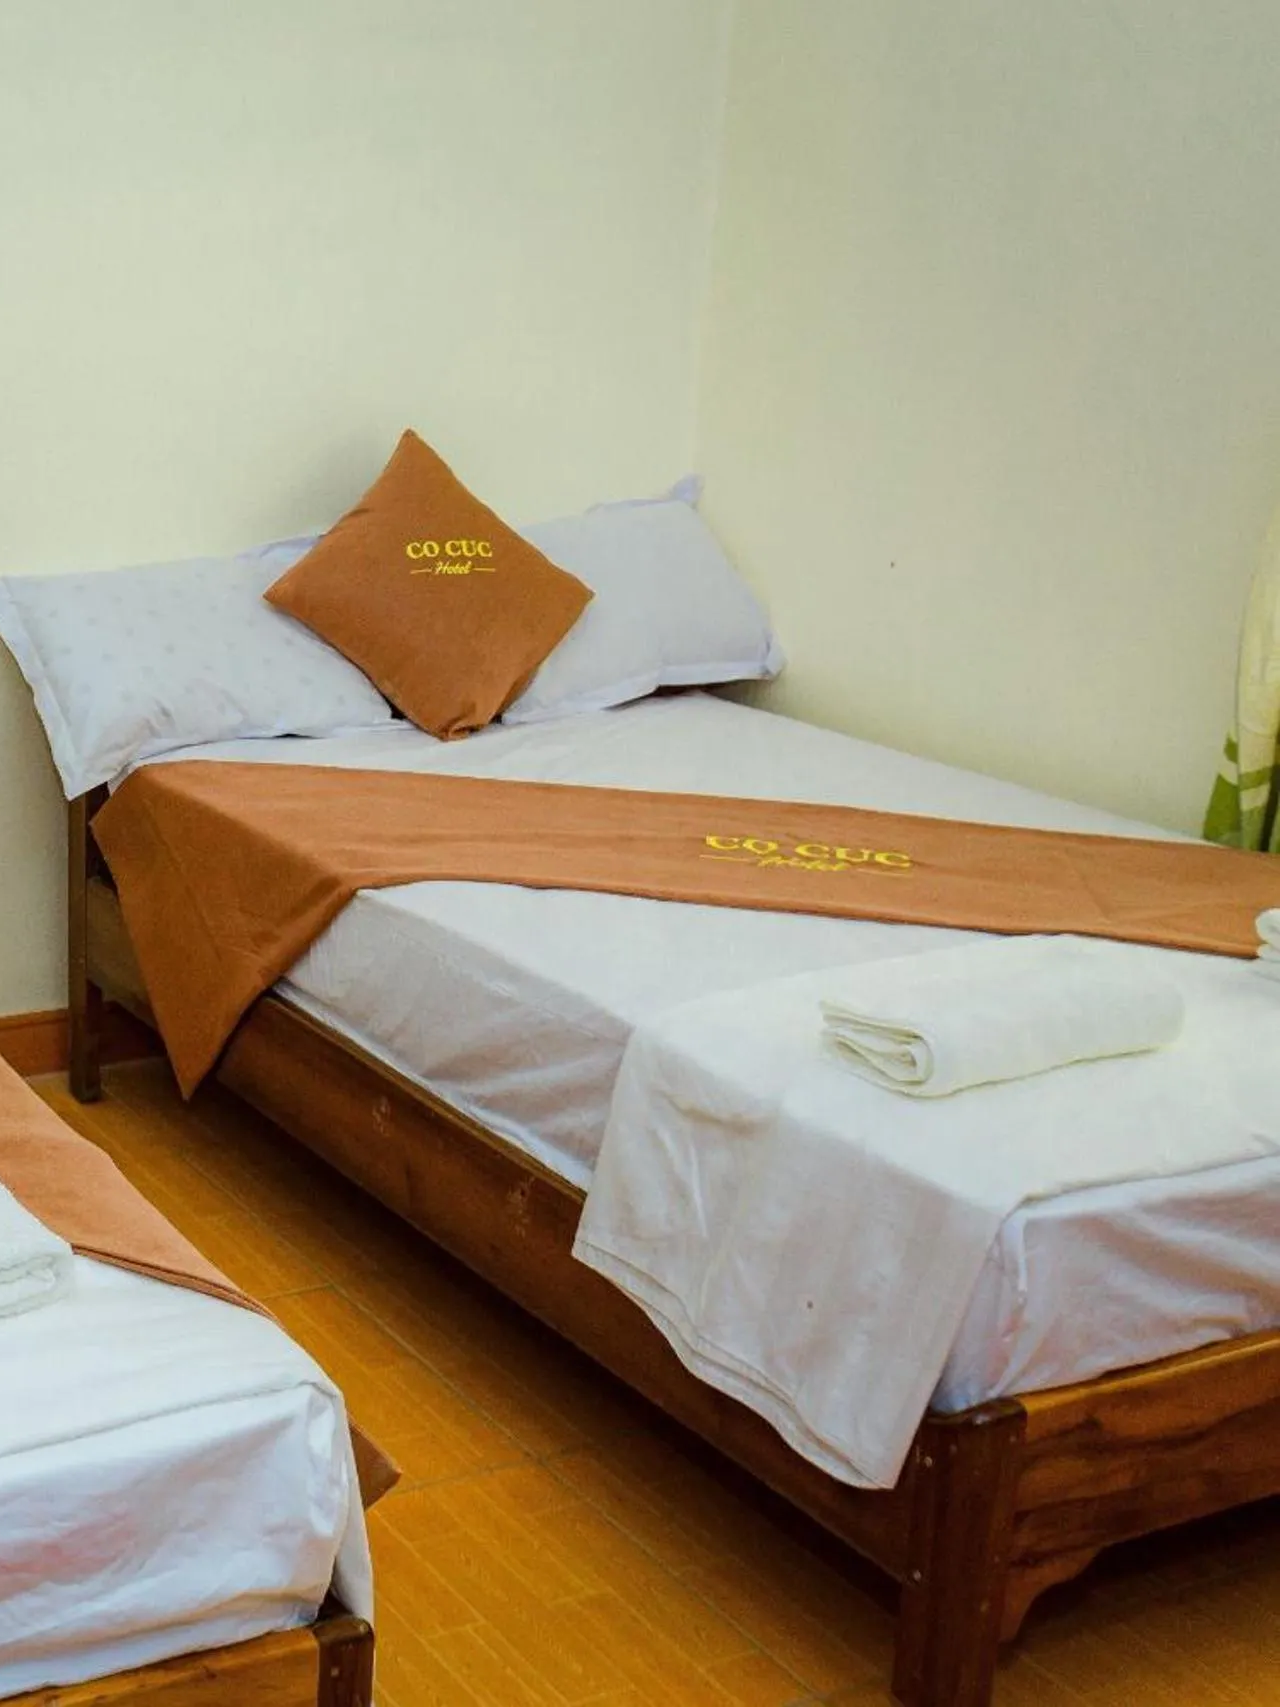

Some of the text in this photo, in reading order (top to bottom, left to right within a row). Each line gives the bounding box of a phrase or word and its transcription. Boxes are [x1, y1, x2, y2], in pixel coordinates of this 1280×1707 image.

[406, 540, 493, 559] CO CUC
[705, 835, 911, 868] CO CUC
